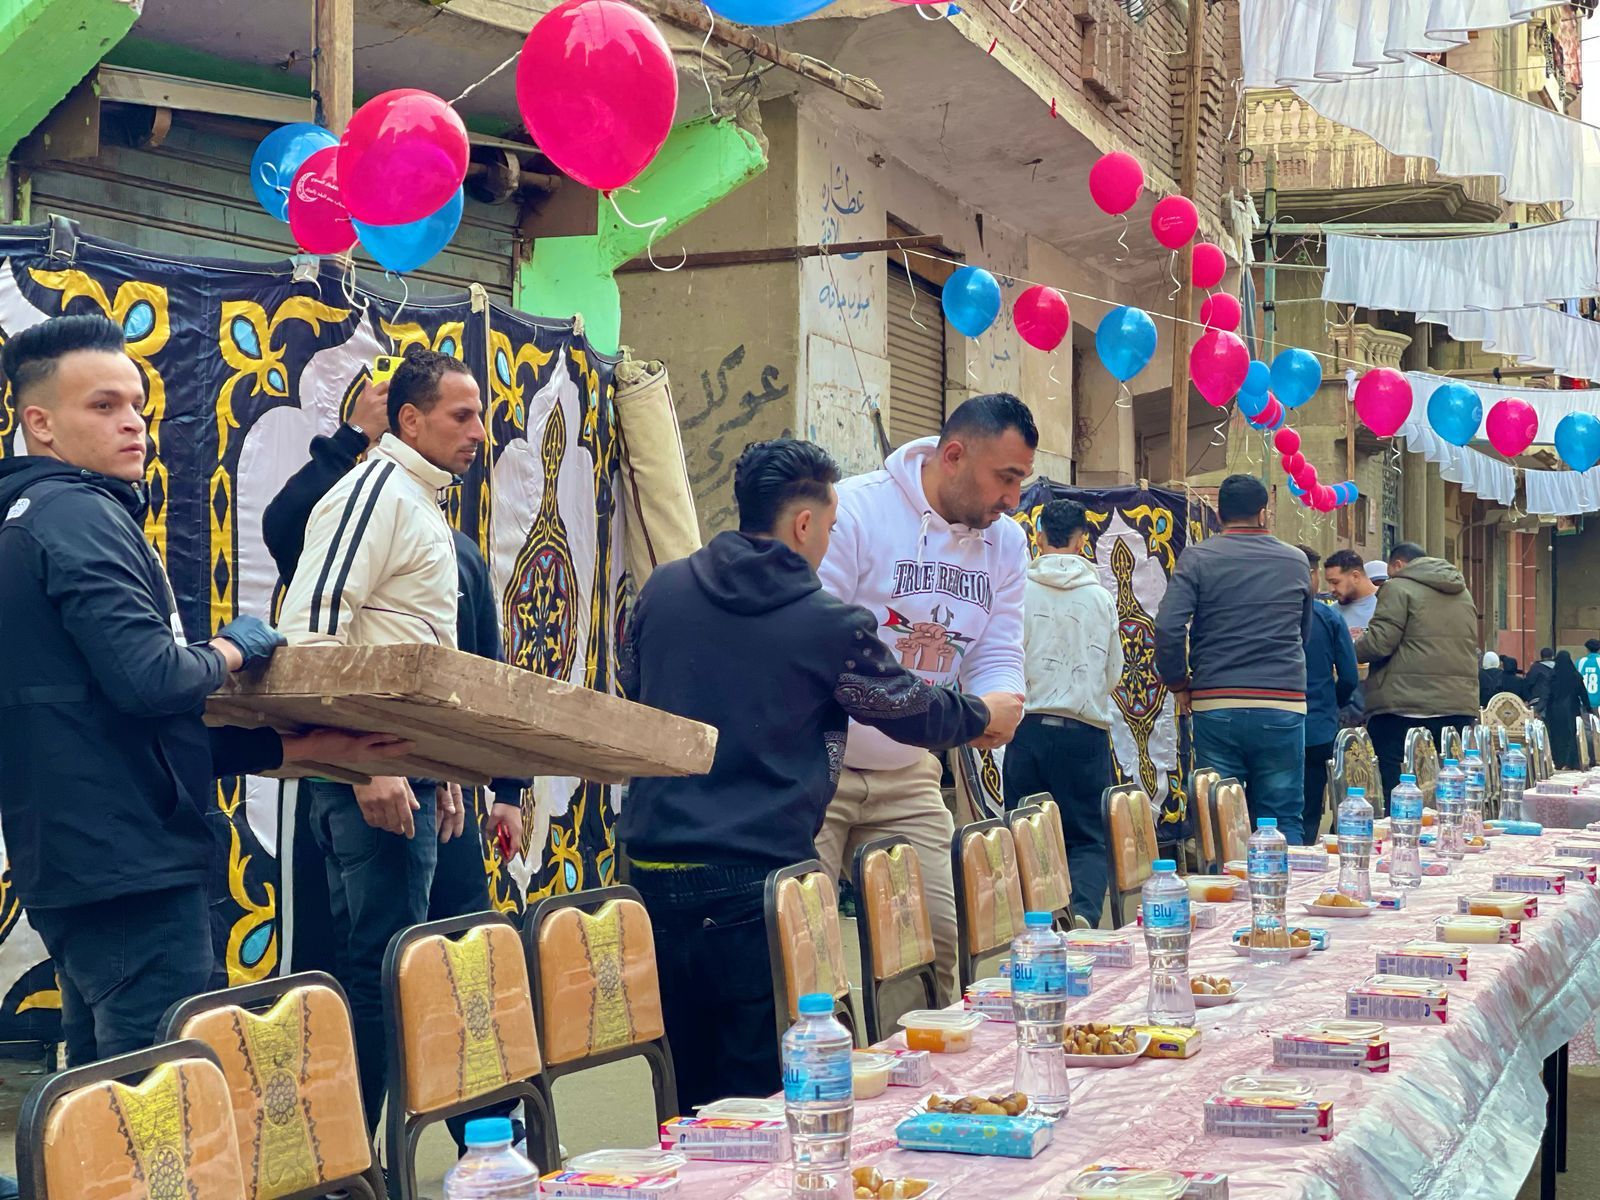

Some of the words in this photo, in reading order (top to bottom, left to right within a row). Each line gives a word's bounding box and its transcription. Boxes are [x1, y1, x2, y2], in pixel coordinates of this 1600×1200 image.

[892, 560, 935, 598] TRUE
[1153, 903, 1172, 919] Blu
[1014, 962, 1032, 980] Blu
